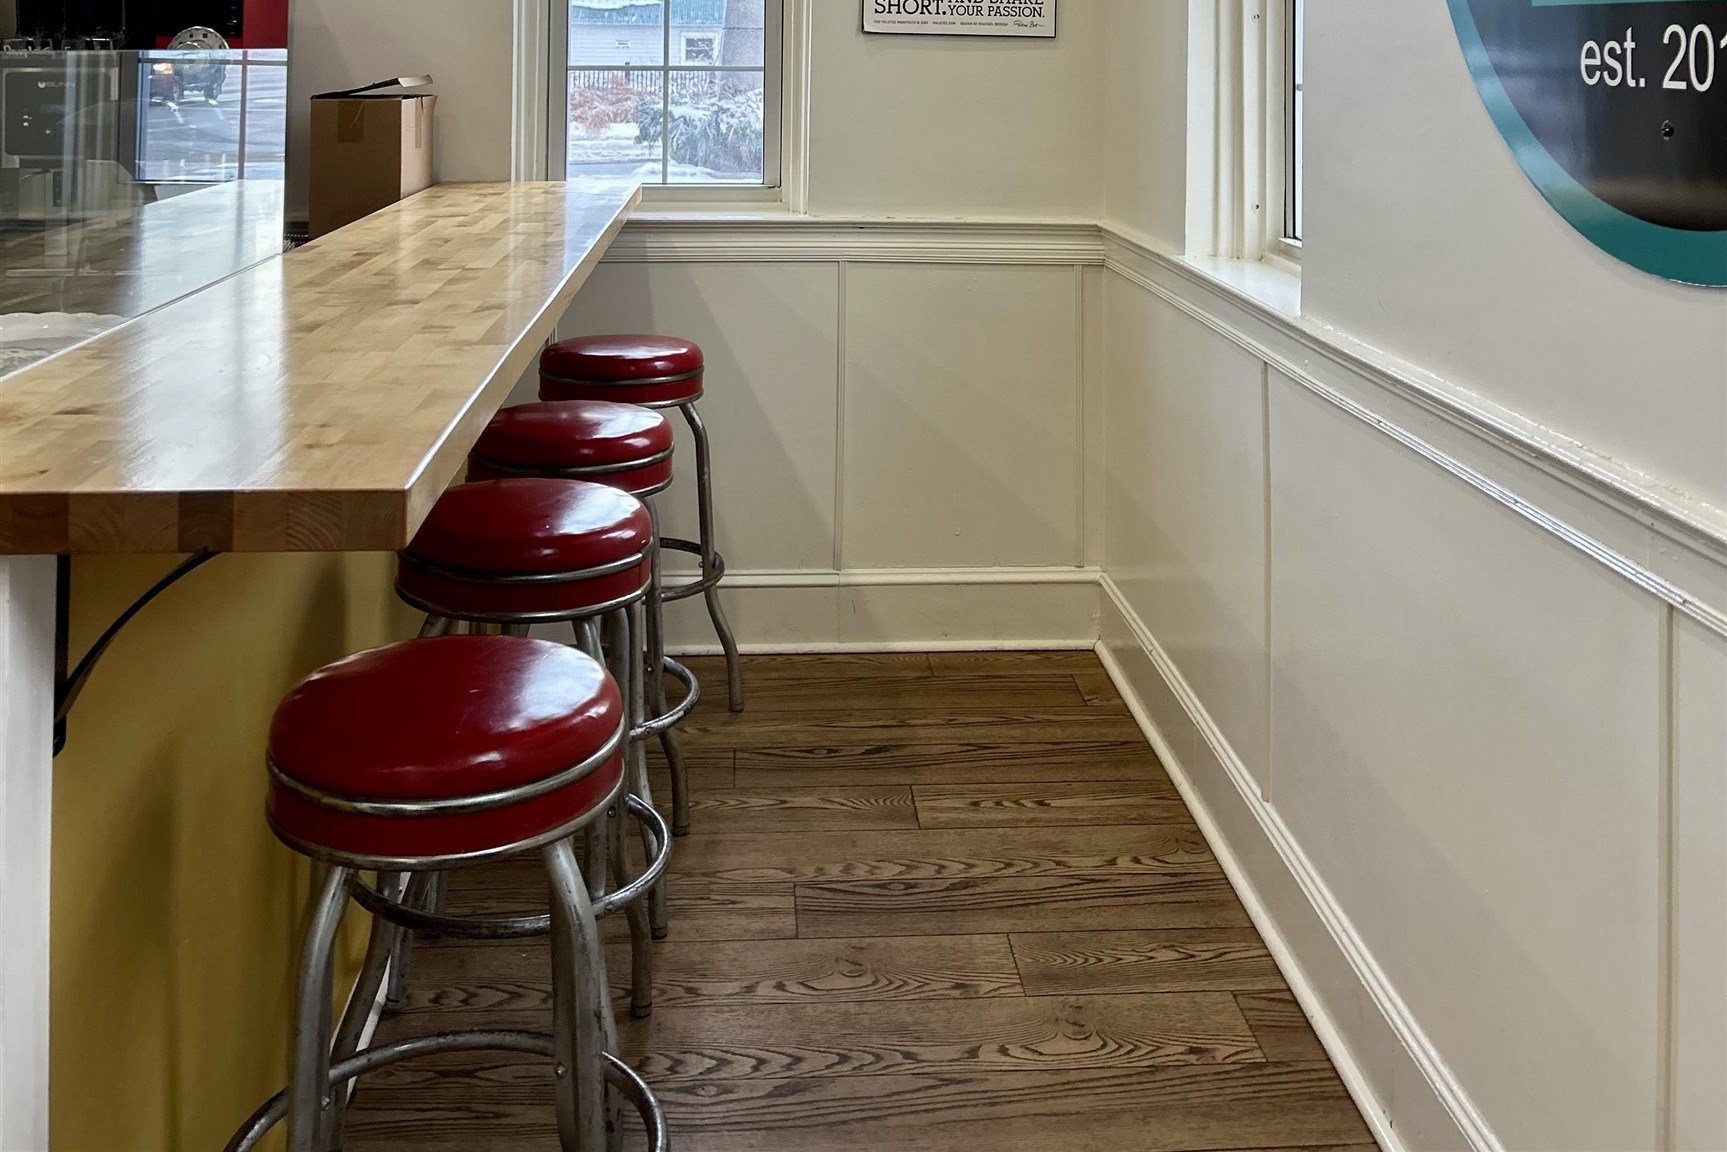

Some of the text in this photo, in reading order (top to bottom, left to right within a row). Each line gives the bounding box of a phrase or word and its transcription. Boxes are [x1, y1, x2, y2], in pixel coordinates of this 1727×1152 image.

[947, 4, 1045, 18] YOUR PASSION.
[1580, 24, 1727, 91] est. 20
